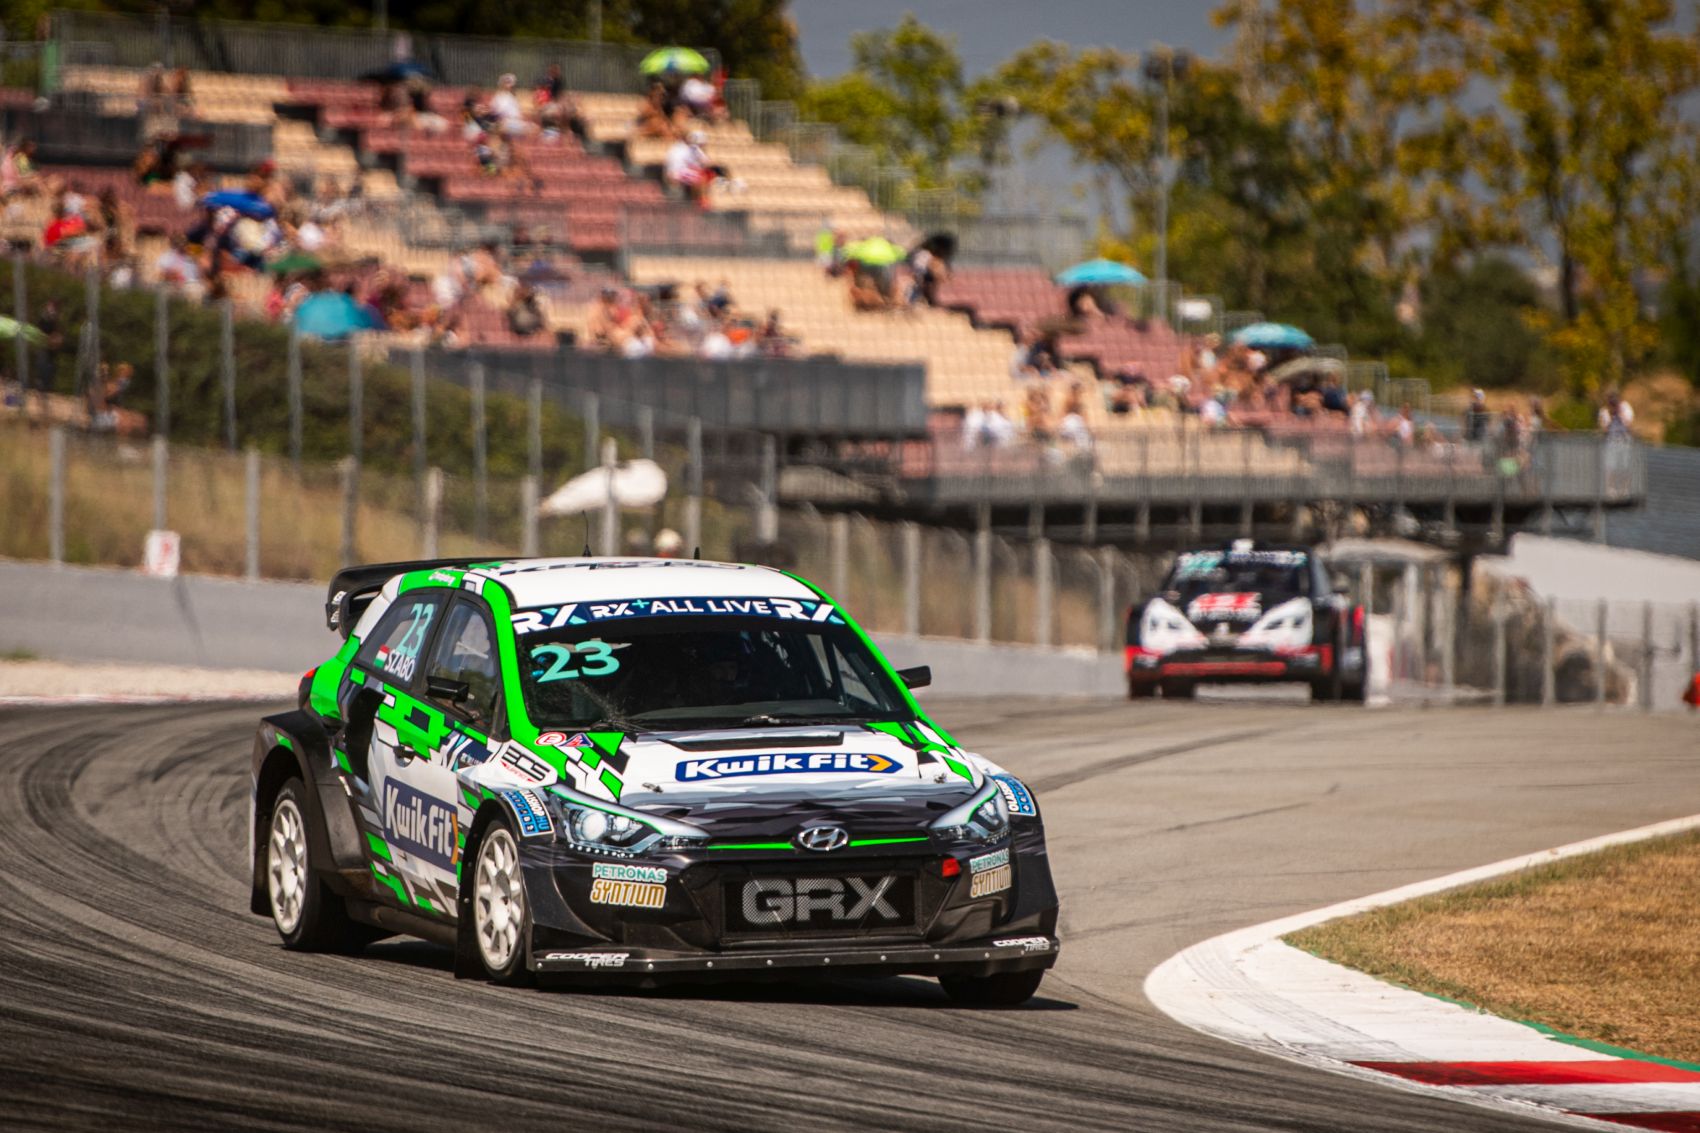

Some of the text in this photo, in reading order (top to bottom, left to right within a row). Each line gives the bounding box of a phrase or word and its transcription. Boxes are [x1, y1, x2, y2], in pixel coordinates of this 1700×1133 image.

[510, 604, 587, 634] RX
[651, 600, 705, 614] ALL
[707, 600, 772, 614] LIVE
[768, 598, 846, 625] RX
[396, 603, 434, 658] 23
[531, 641, 620, 683] 23
[593, 863, 667, 882] PETRONAS
[970, 849, 1009, 873] PETRONAS
[591, 880, 666, 907] SYNTIUM
[971, 865, 1011, 897] SYNTIUM
[742, 876, 900, 923] GRX
